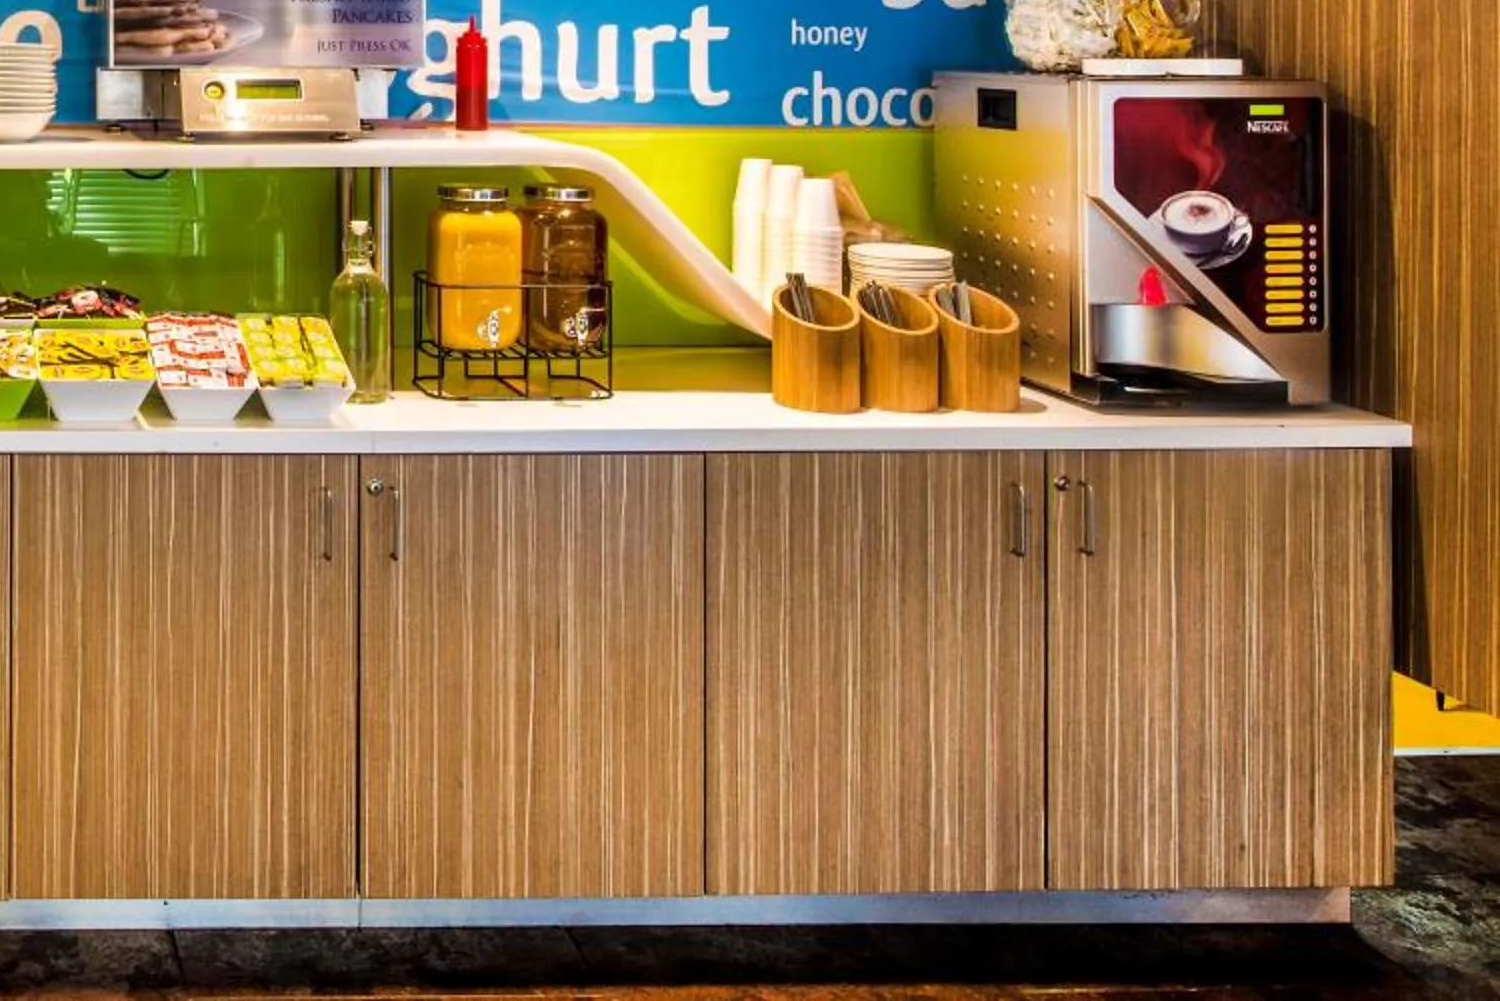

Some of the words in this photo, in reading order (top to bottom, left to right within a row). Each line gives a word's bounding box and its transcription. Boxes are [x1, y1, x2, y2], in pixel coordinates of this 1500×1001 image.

[332, 8, 413, 24] PANCAKES
[791, 19, 869, 52] honey
[317, 39, 345, 53] JUST
[389, 38, 410, 52] OK
